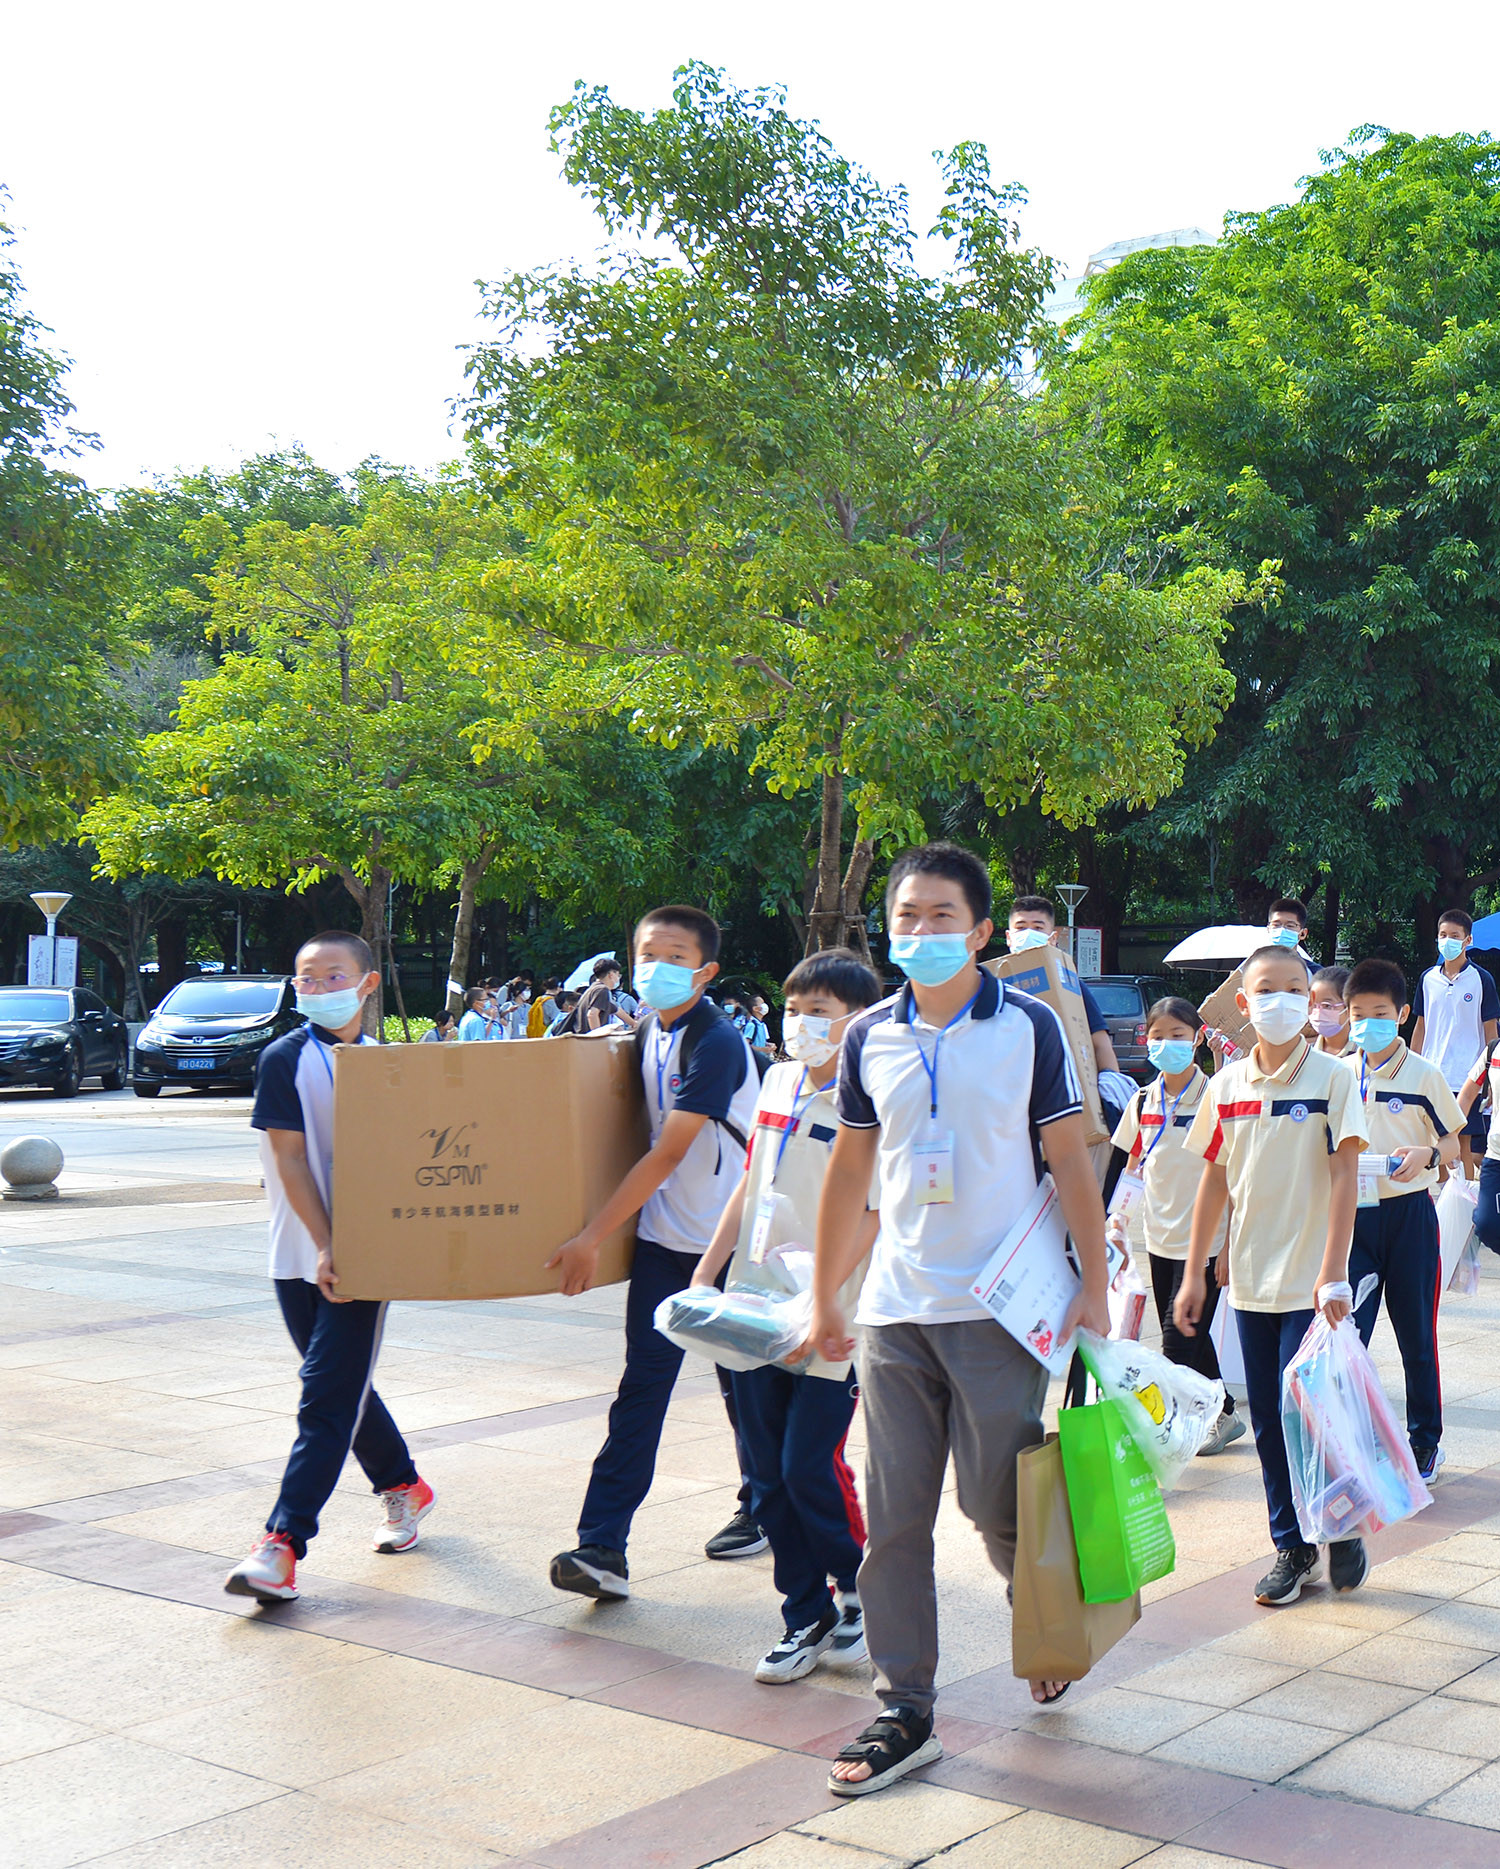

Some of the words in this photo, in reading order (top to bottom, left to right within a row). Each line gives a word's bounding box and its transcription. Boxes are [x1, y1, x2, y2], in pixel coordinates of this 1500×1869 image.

[391, 1203, 520, 1220] 青少年航海模型器材
